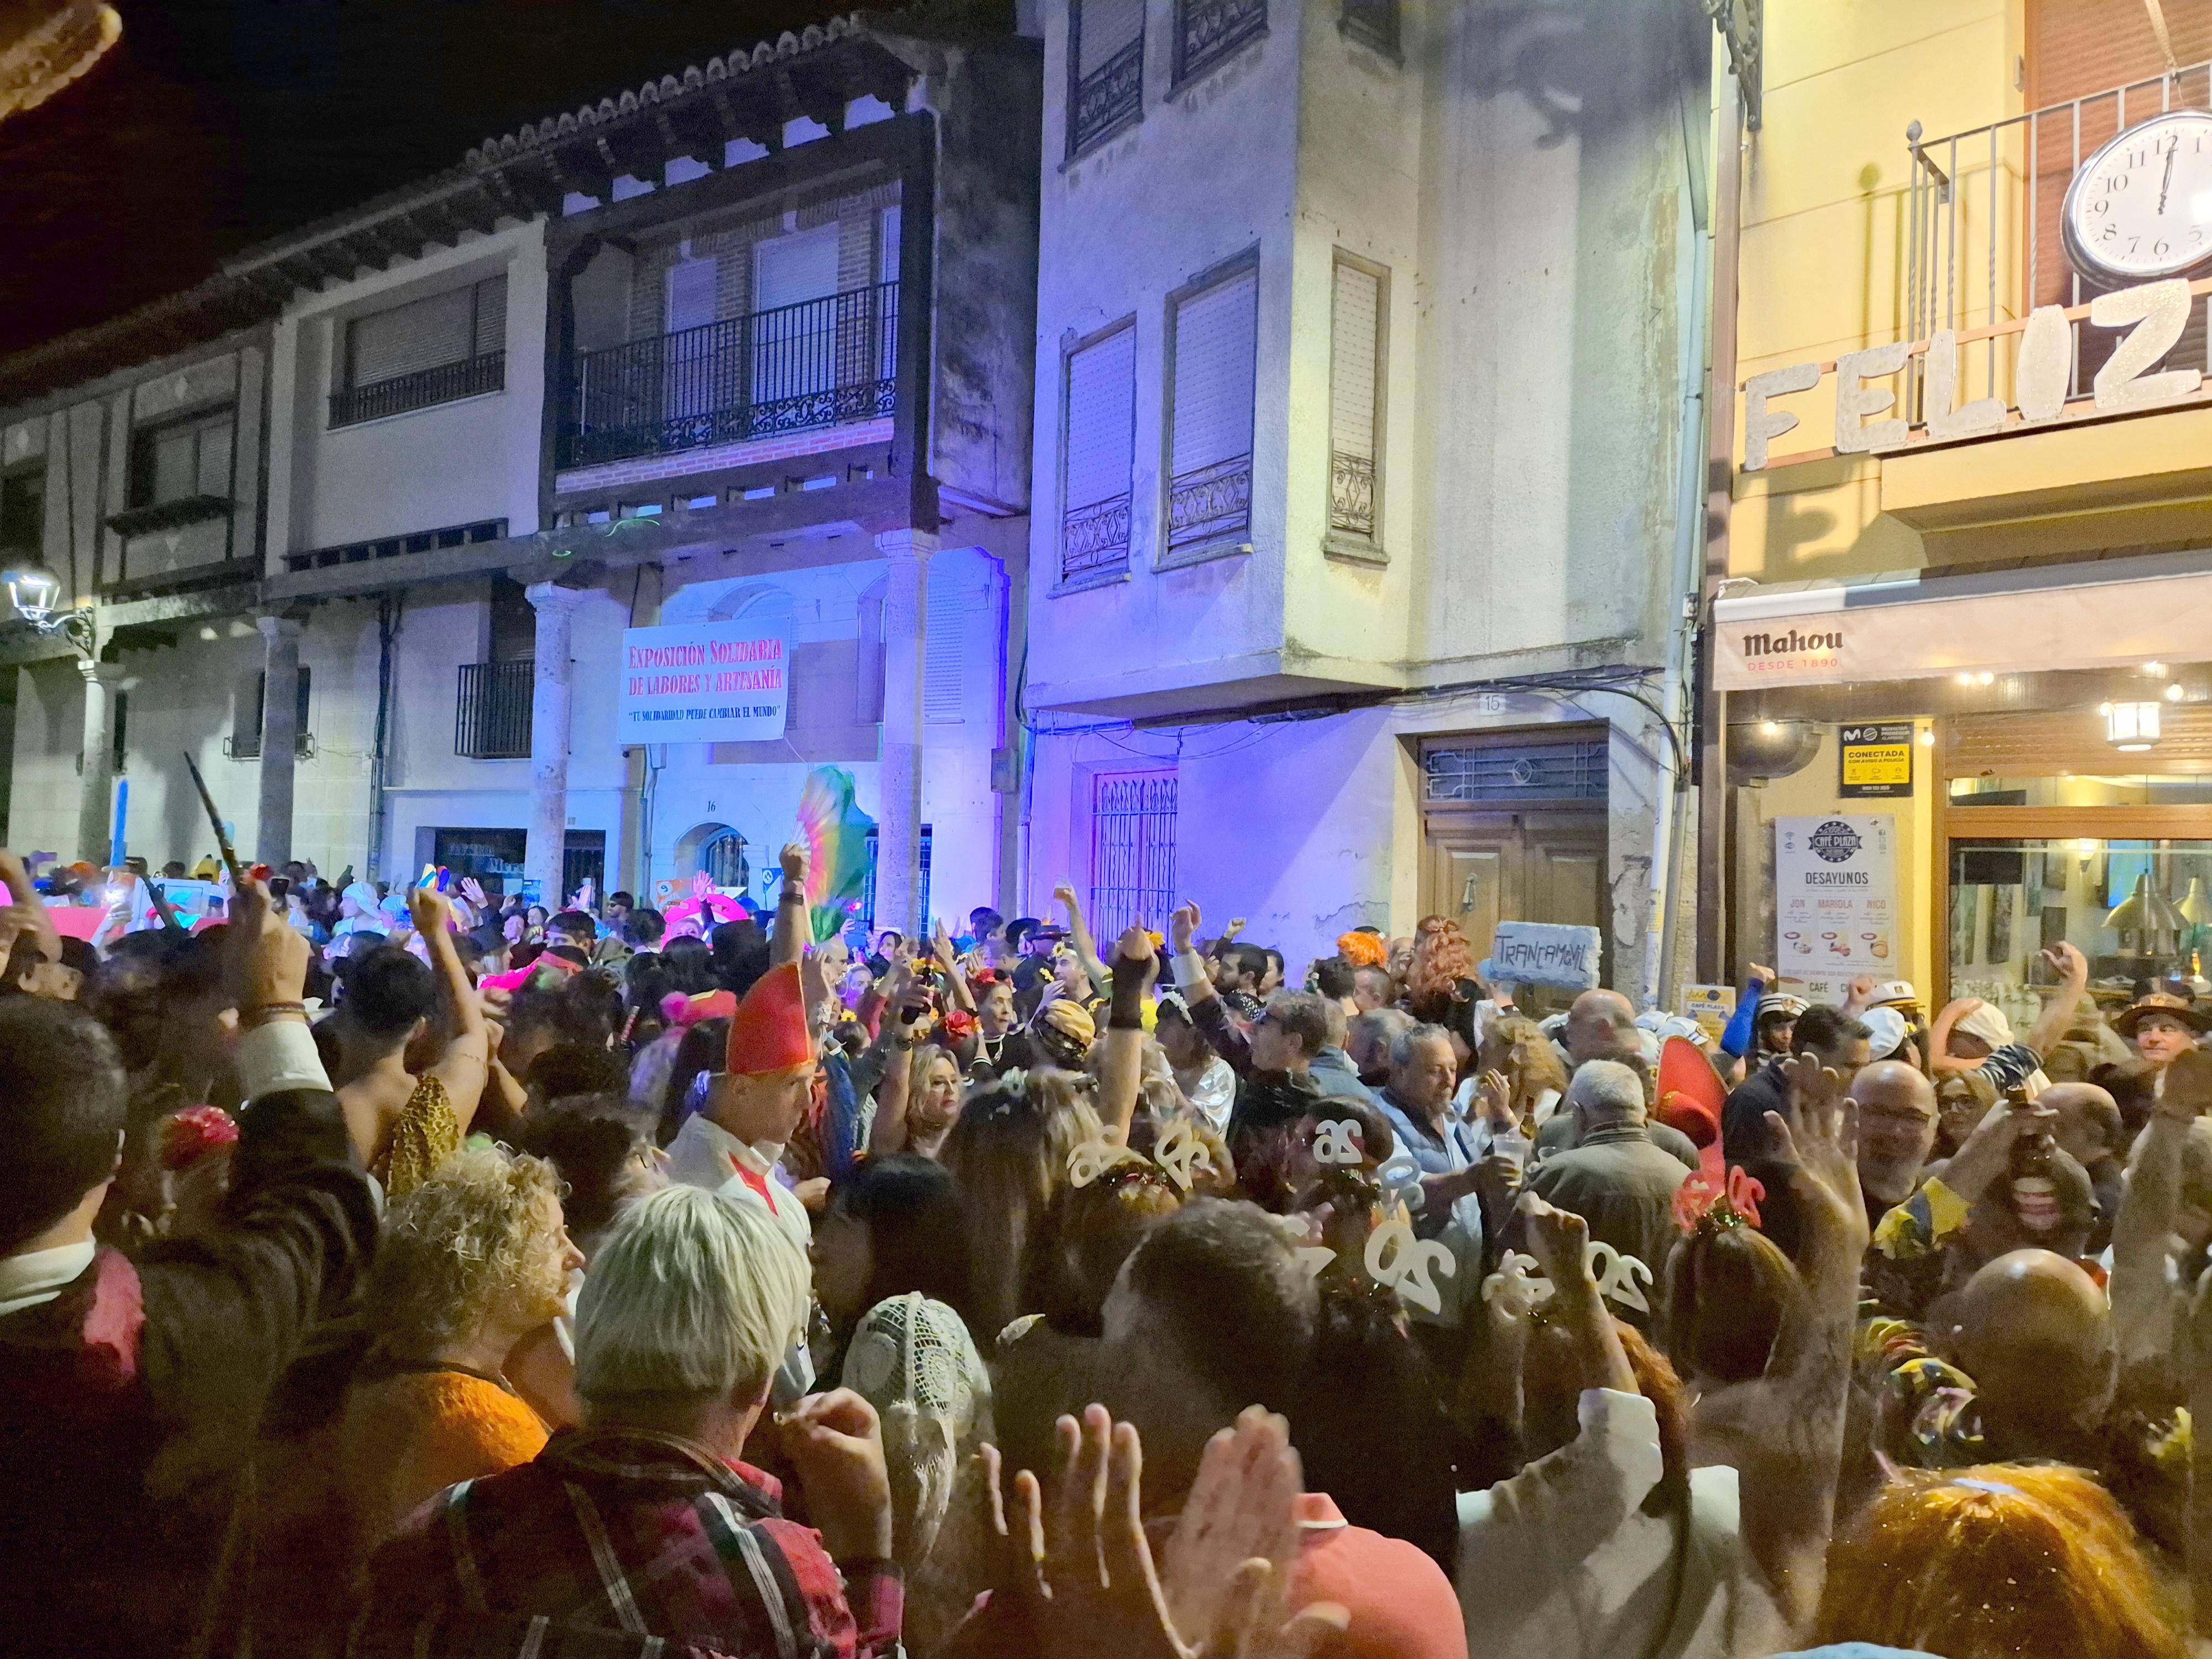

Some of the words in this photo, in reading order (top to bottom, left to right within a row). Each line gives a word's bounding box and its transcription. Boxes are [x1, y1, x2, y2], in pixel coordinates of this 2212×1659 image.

[2127, 150, 2146, 169] 11
[2104, 174, 2128, 194] 10
[2094, 200, 2109, 218] 9
[2103, 224, 2117, 241] 8
[2188, 225, 2202, 242] 5
[2128, 236, 2140, 253] 7
[2154, 237, 2169, 255] 6
[1744, 278, 2201, 471] FELIZ
[1747, 660, 1794, 671] DESDE
[1802, 658, 1838, 669] 1890
[629, 677, 644, 696] DE
[648, 674, 701, 695] LABORES
[705, 674, 713, 692] Y
[716, 665, 782, 691] ARTESANÍA
[1485, 695, 1500, 711] 15
[643, 709, 684, 721] SOLIDARIDAD
[686, 708, 707, 720] PUEDE
[709, 707, 741, 719] CAMBIAR
[743, 706, 751, 717] EL
[707, 800, 716, 812] 16
[1806, 872, 1869, 884] DESAYUNOS
[1818, 899, 1854, 909] MARIOLA
[1867, 900, 1886, 909] NICO
[1809, 982, 1828, 993] CAFÉ
